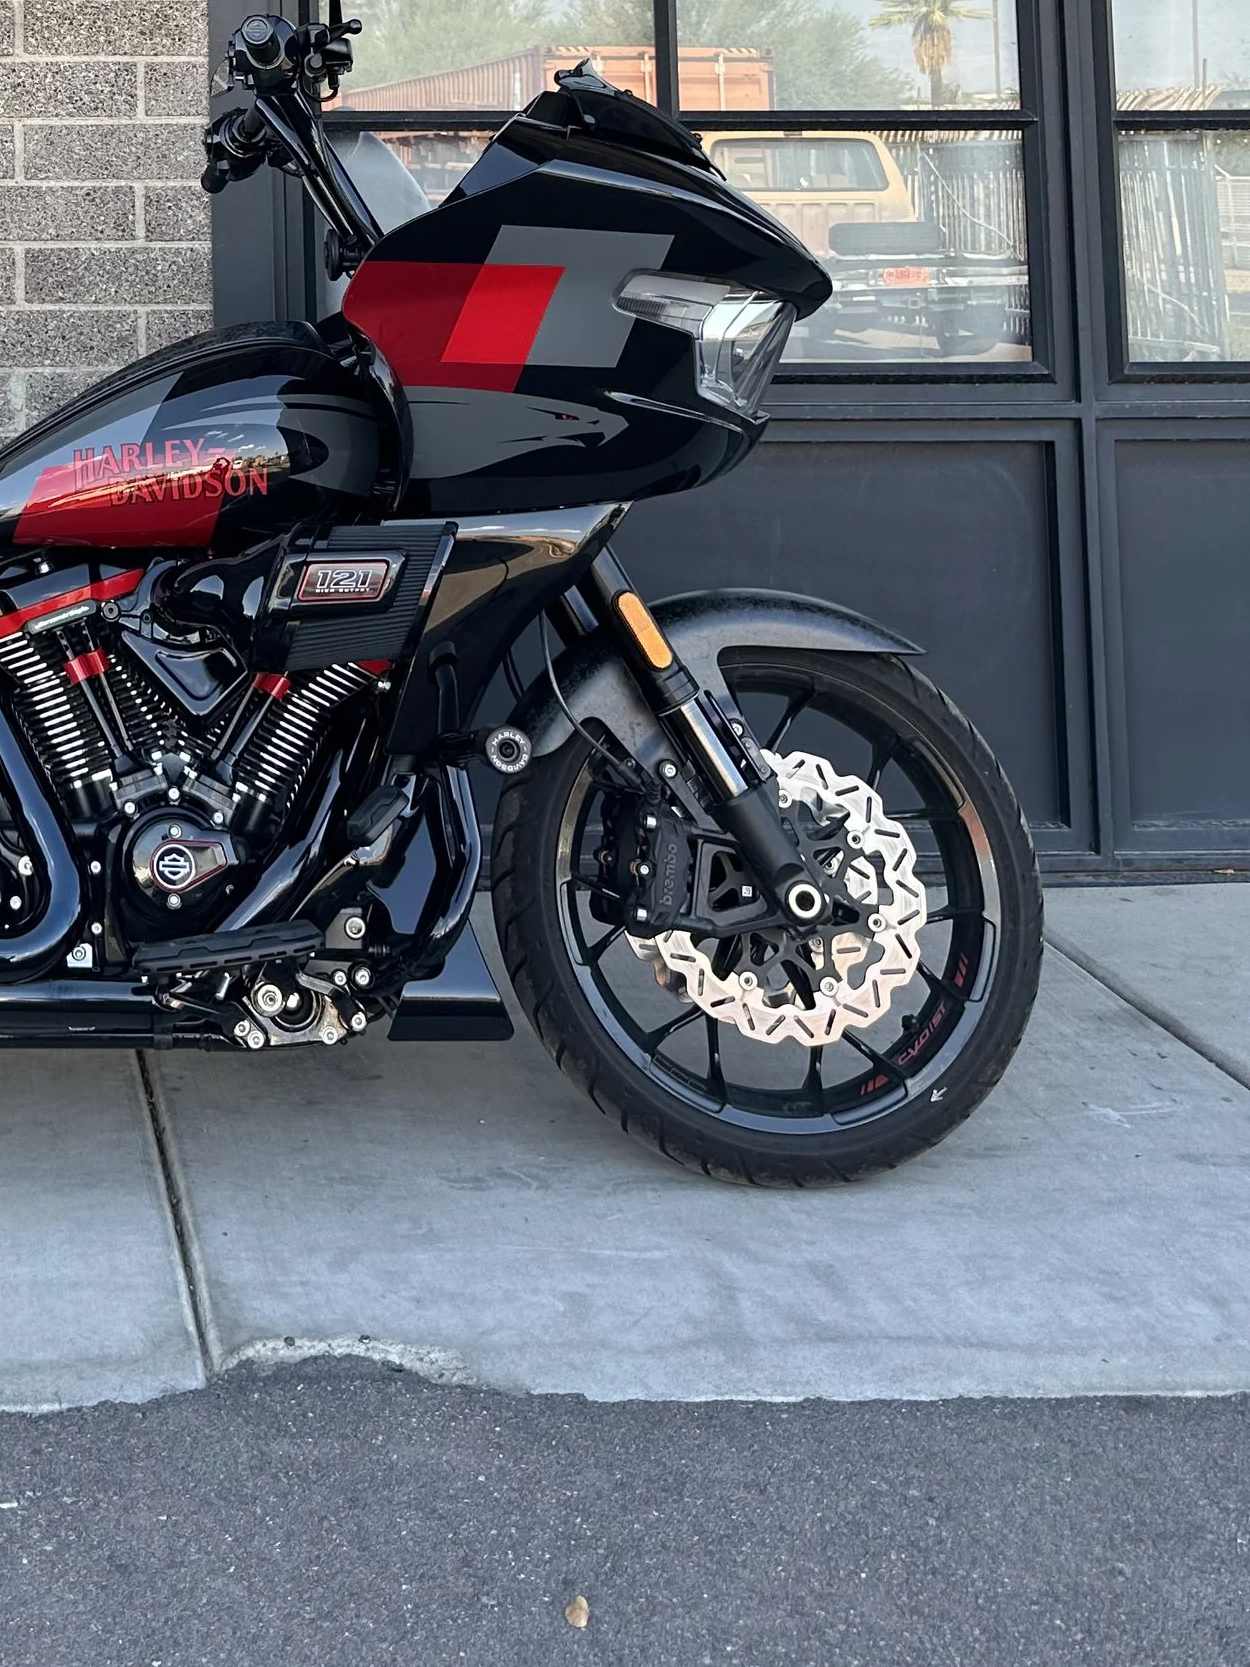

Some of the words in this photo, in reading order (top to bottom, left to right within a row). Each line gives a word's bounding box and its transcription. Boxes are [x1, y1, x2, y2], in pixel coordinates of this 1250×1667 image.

[108, 467, 269, 506] DAVIDSON
[316, 569, 372, 588] 121
[658, 843, 678, 906] brembo
